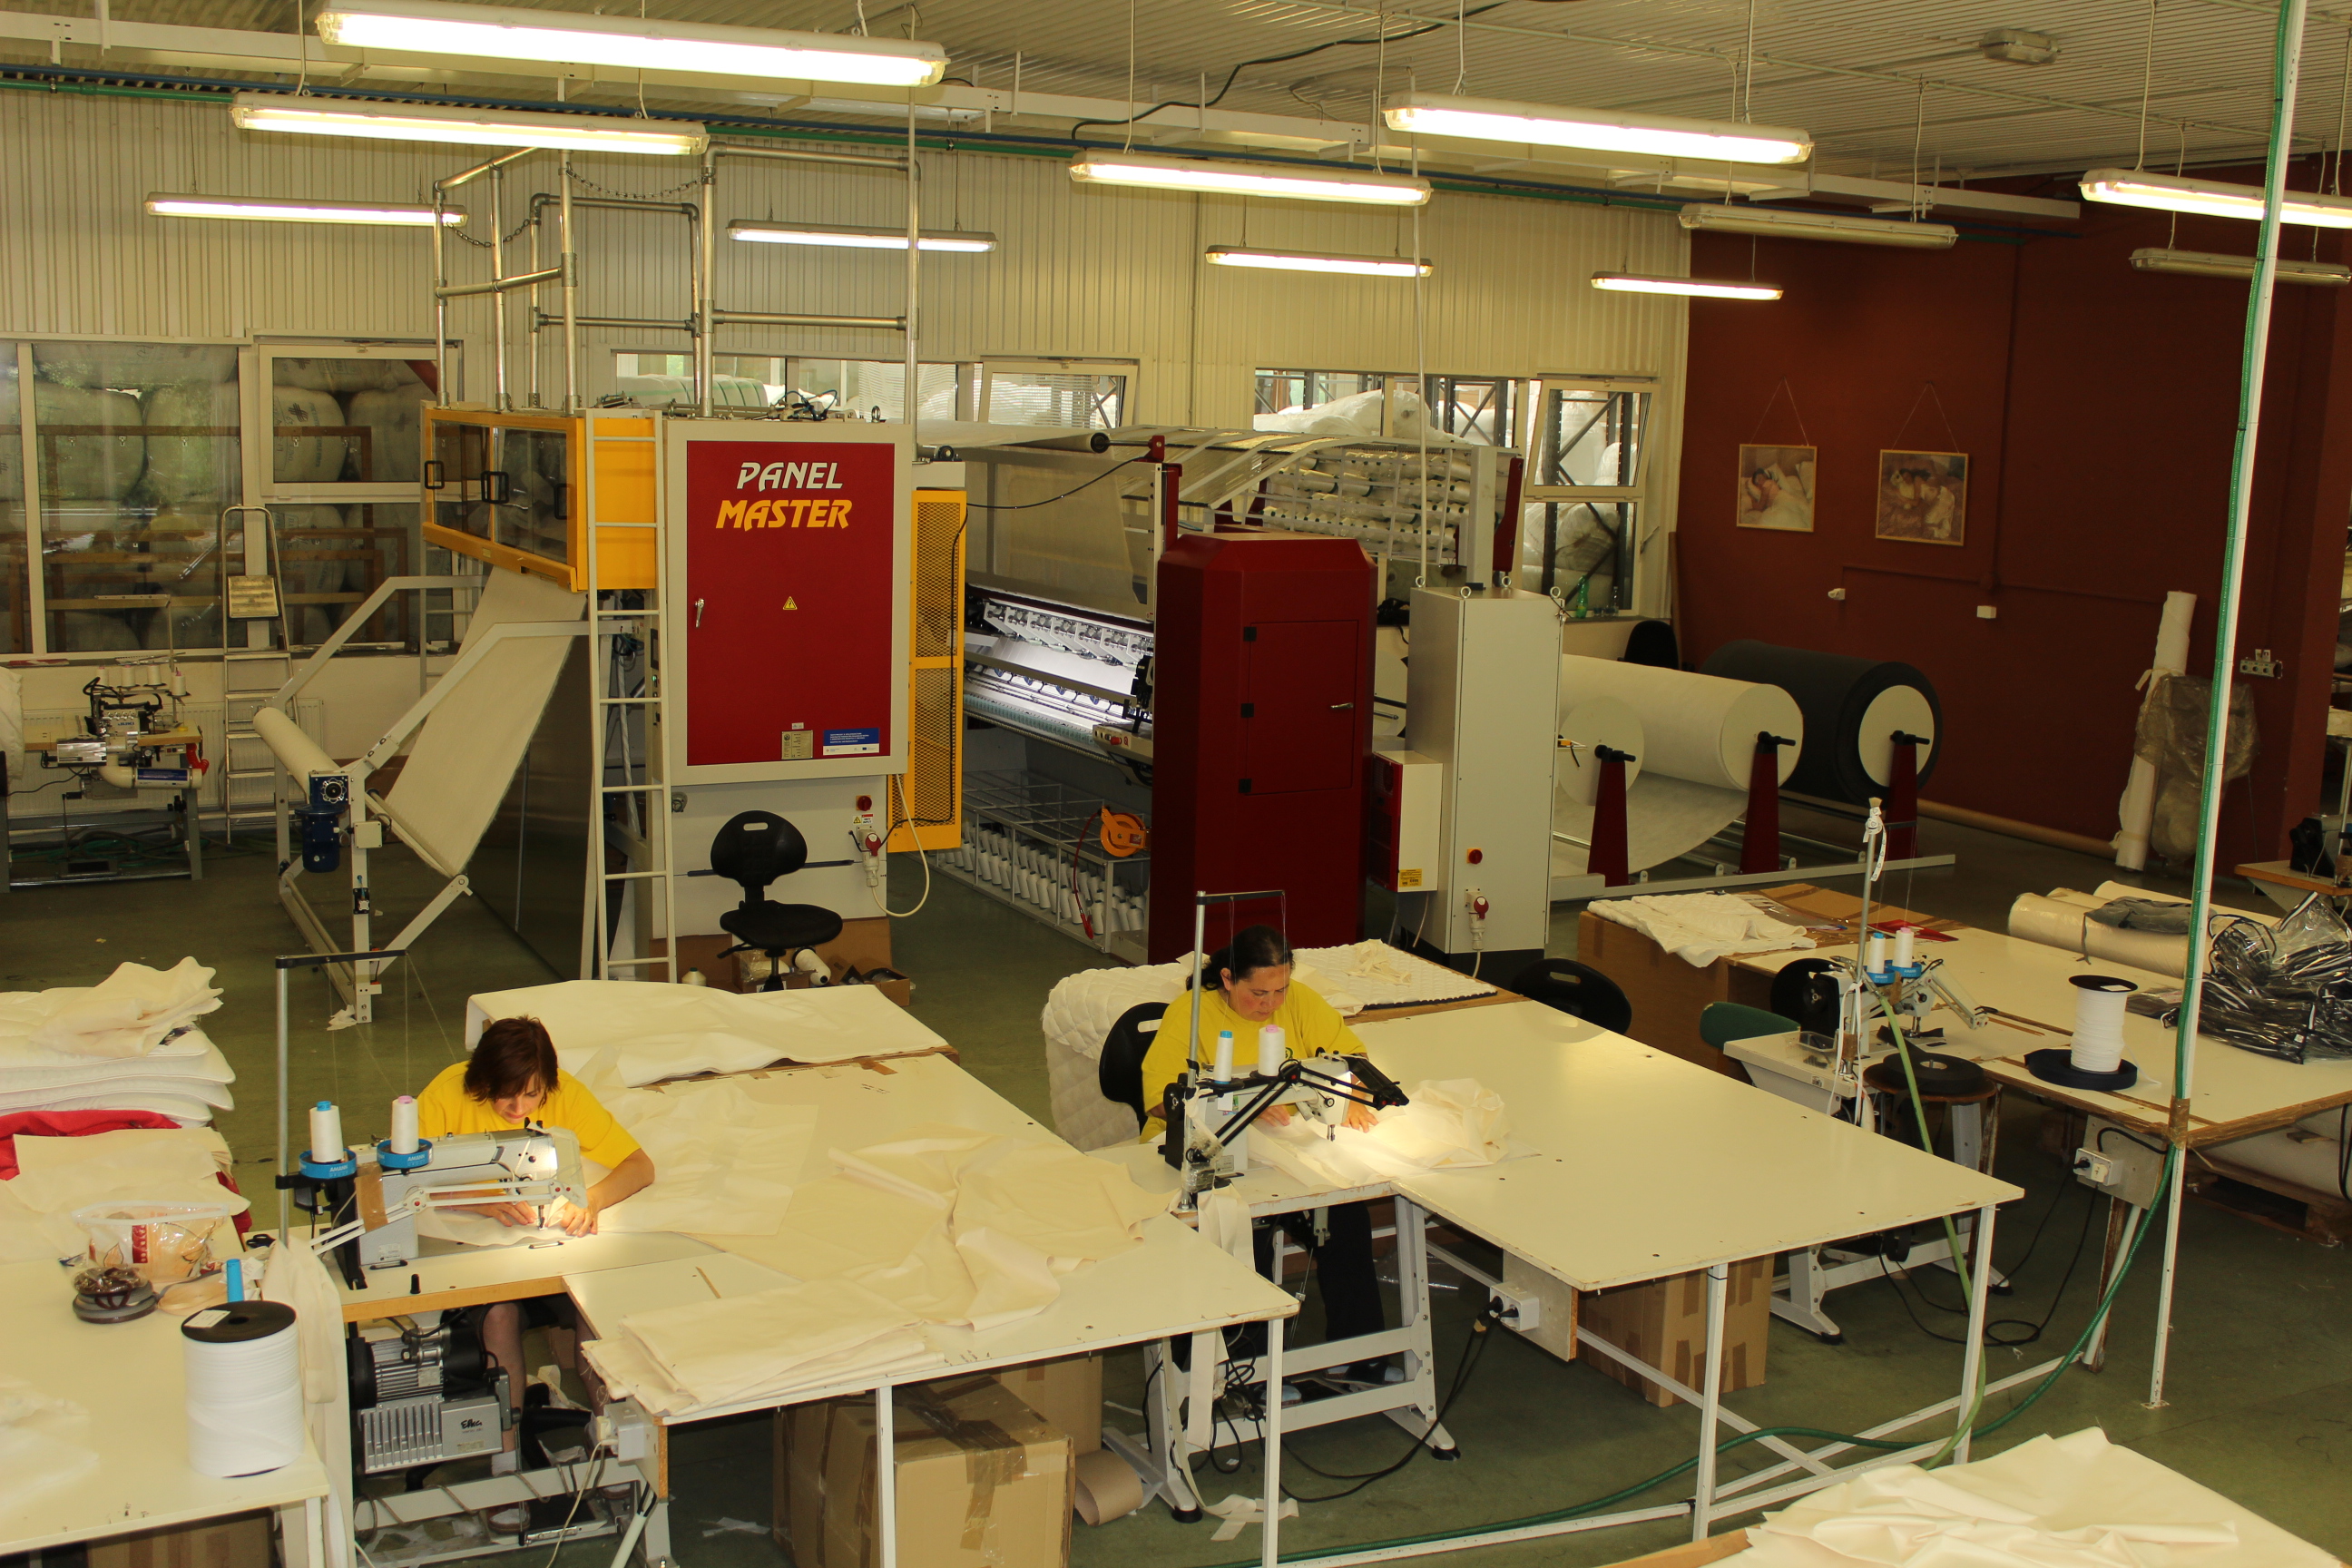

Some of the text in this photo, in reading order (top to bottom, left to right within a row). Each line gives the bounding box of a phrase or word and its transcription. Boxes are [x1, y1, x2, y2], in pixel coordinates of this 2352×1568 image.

[736, 461, 844, 493] PANEL
[715, 499, 853, 532] MASTER
[329, 1164, 348, 1172] AMANN
